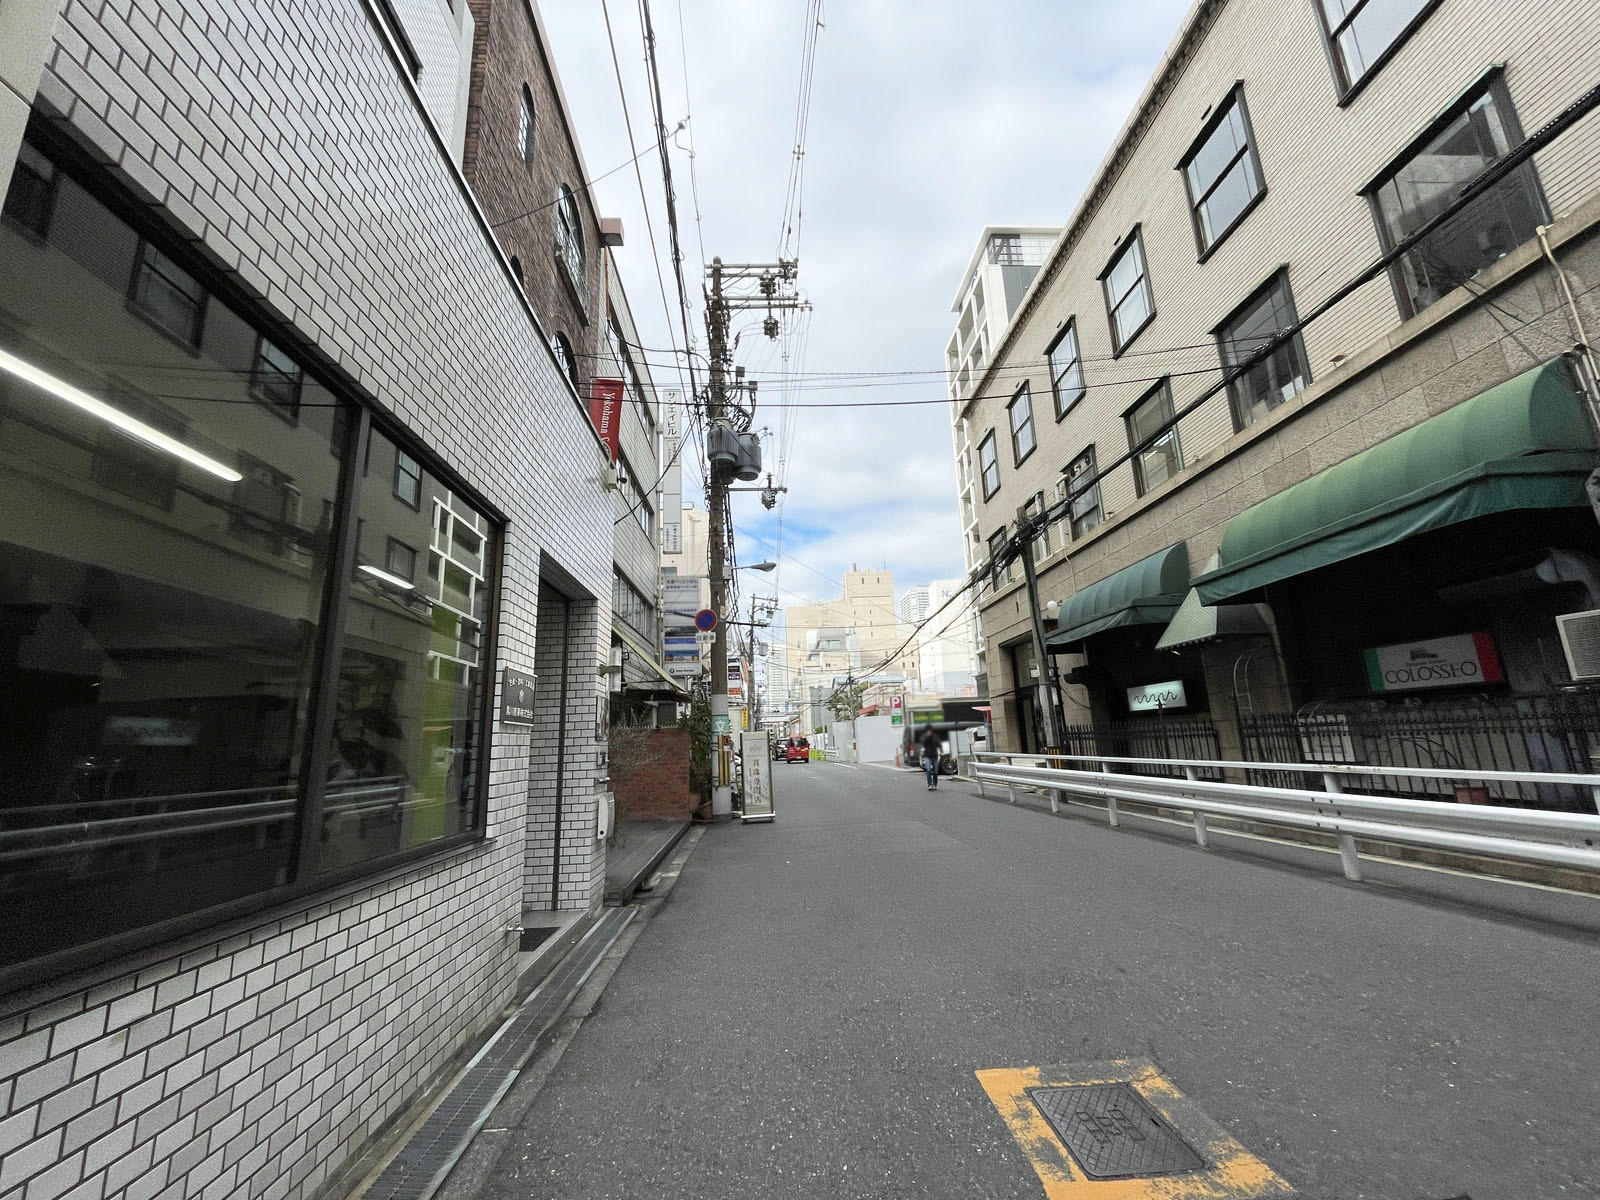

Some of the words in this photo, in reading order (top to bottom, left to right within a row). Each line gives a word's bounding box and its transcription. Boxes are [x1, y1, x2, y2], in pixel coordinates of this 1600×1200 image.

[600, 392, 616, 434] Yokohama
[667, 392, 677, 436] サンエイビル
[1384, 660, 1478, 684] COLOSSEO
